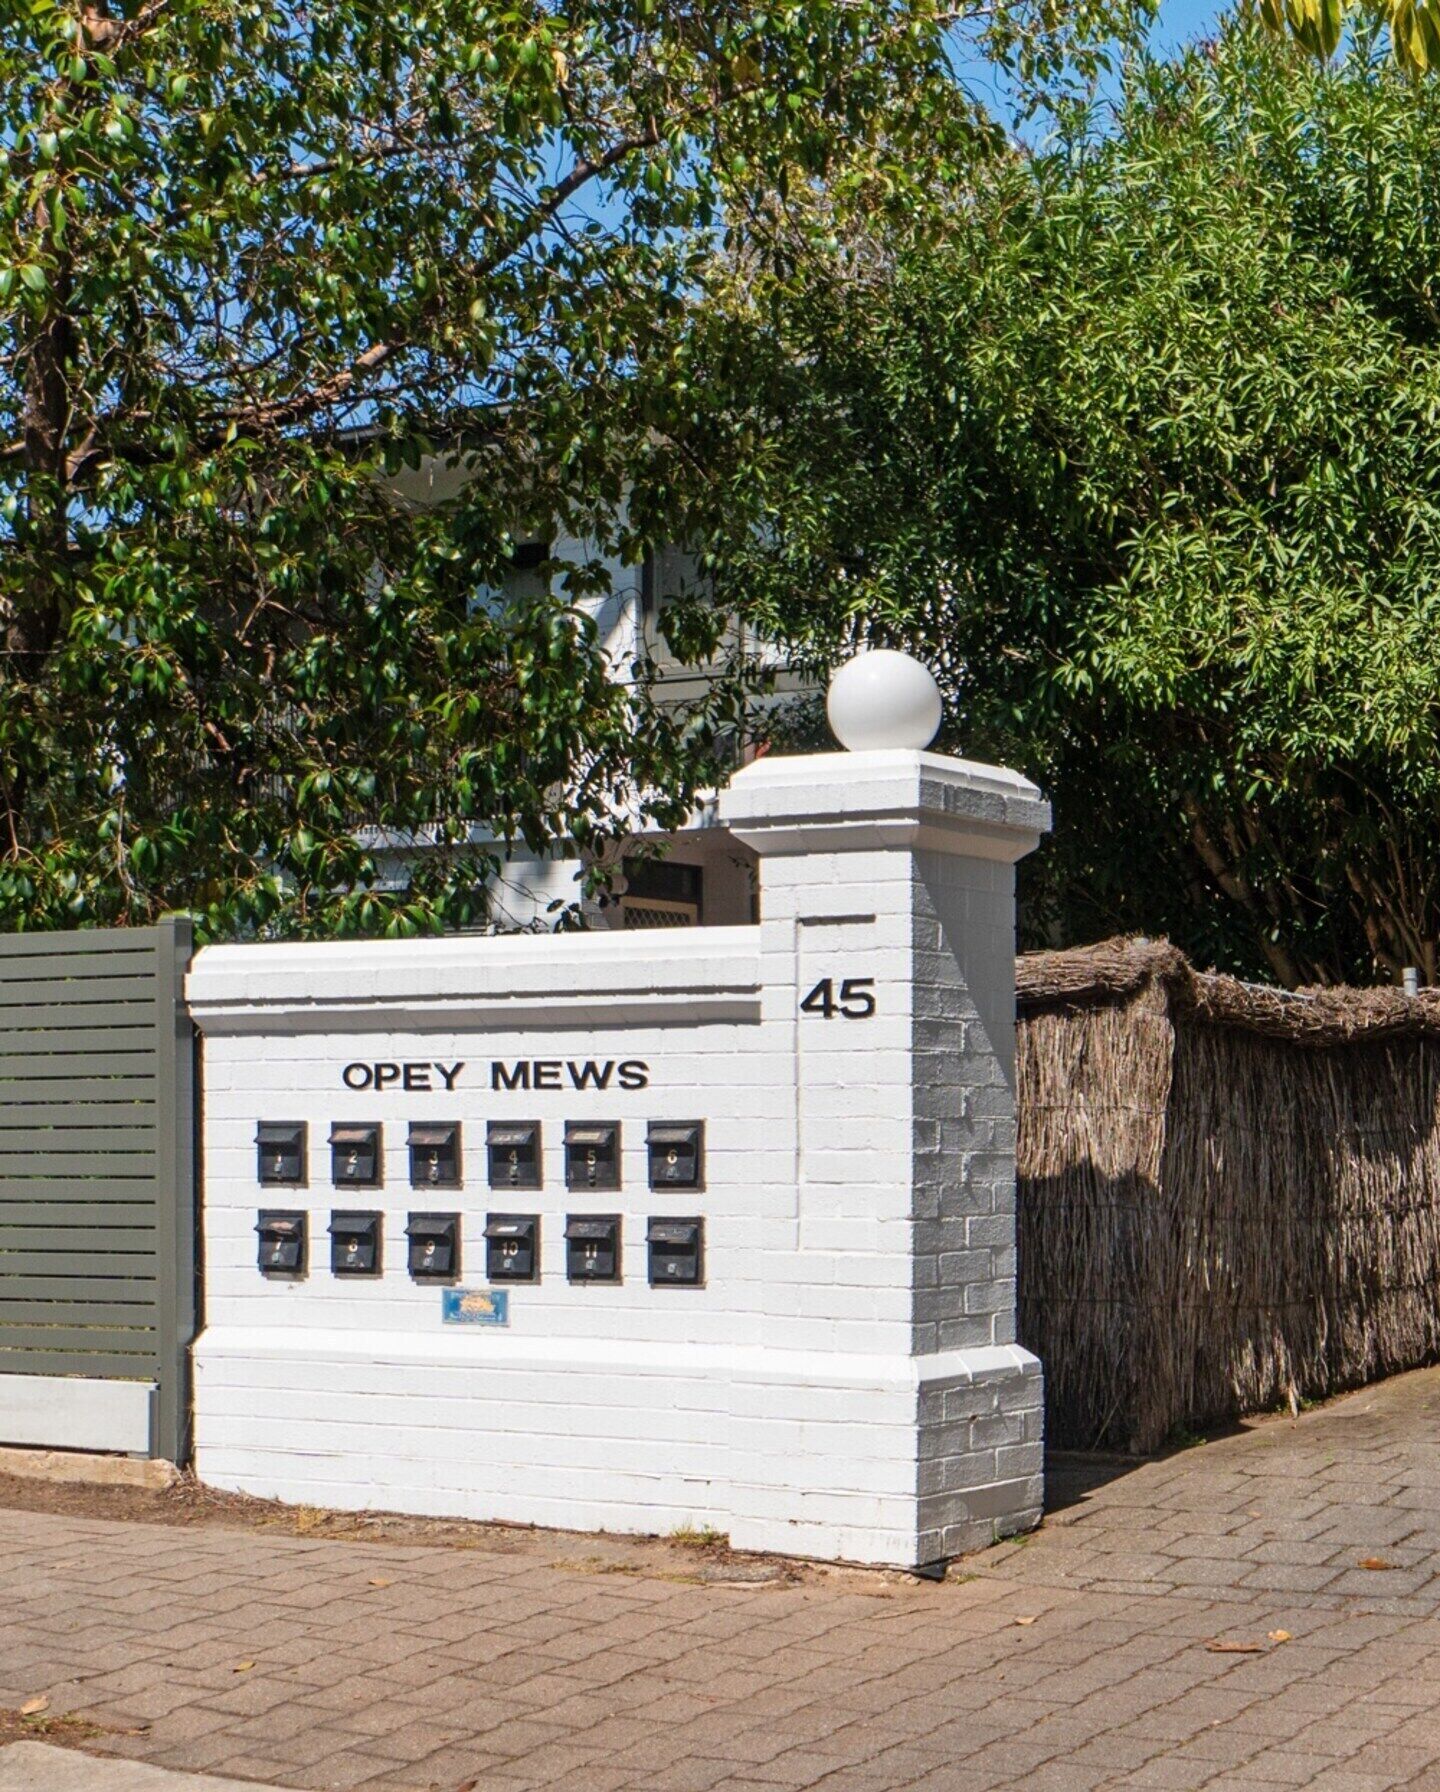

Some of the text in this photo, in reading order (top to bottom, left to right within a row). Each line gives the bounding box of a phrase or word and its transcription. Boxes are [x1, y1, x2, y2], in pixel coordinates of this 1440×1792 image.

[800, 977, 876, 1019] 45
[342, 1060, 650, 1091] OPEY MEWS
[349, 1150, 358, 1163] 2
[429, 1150, 438, 1164] 3
[508, 1150, 518, 1164] 4
[586, 1150, 596, 1165] 5
[667, 1149, 678, 1164] 6
[274, 1236, 284, 1250] 7
[425, 1240, 435, 1255] 9
[501, 1241, 519, 1256] 10
[585, 1243, 598, 1258] 11
